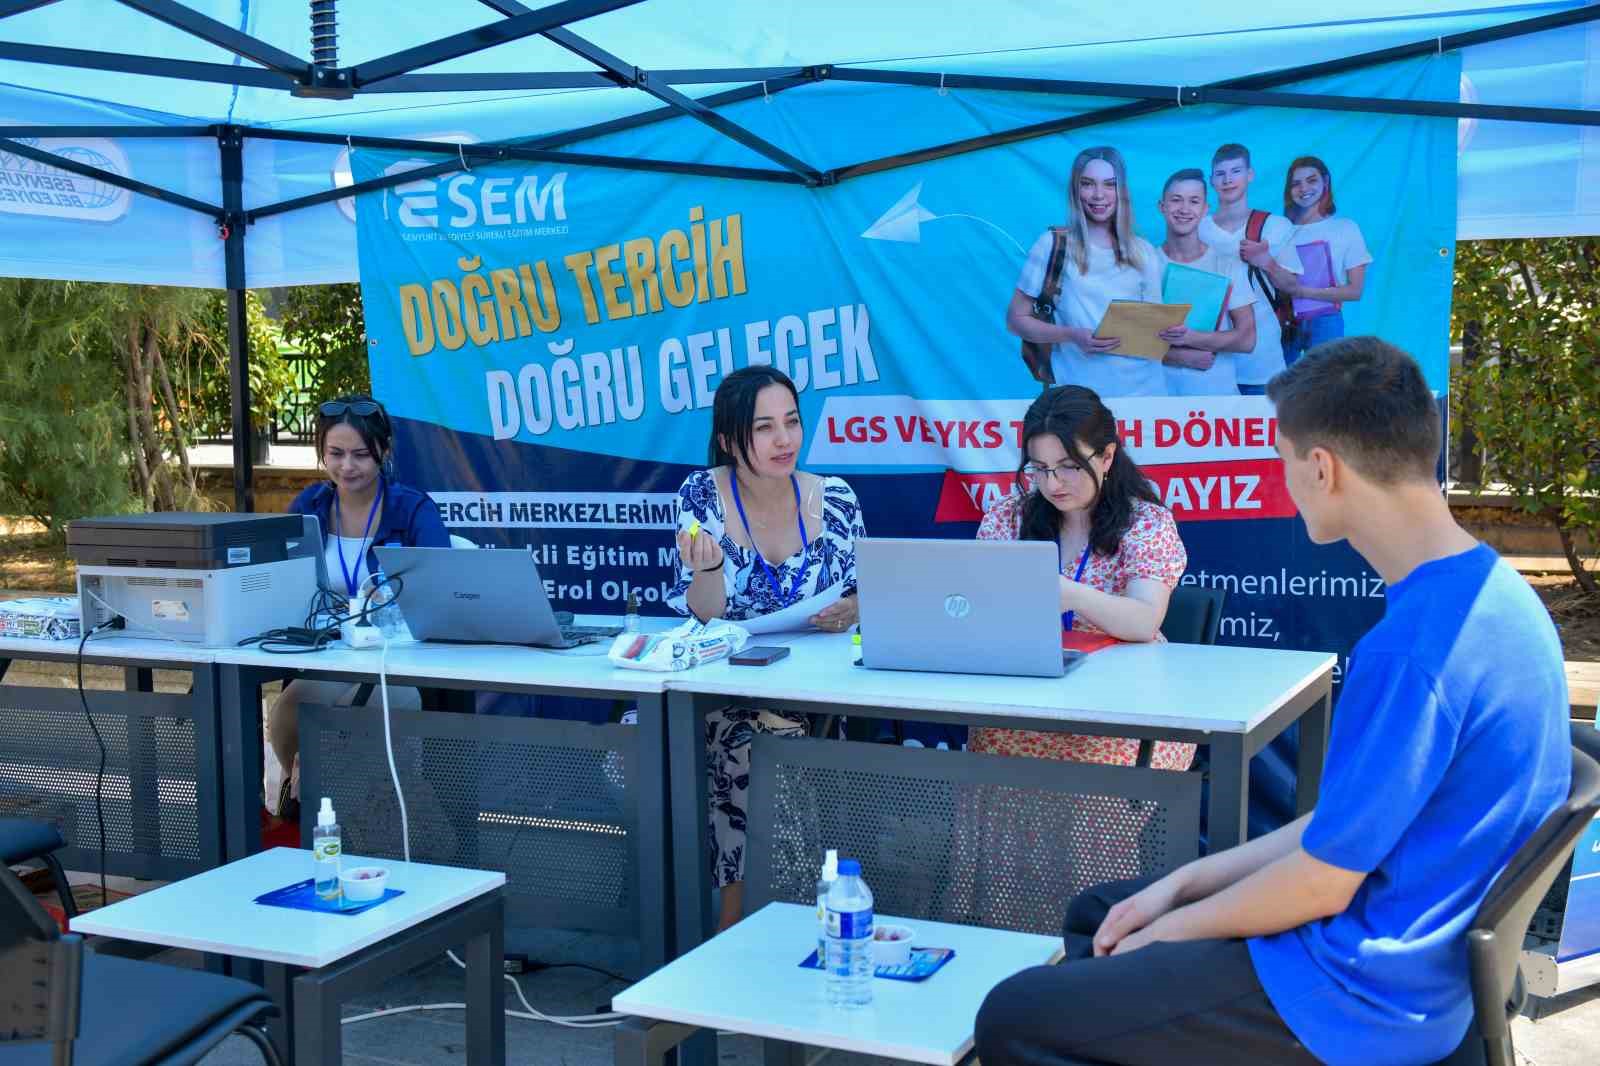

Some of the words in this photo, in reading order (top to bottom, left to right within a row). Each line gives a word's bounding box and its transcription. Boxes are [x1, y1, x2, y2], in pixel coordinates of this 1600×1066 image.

[399, 255, 562, 357] DOĞRU
[563, 204, 748, 326] TERCİH
[485, 338, 645, 440] DOĞRU
[827, 416, 888, 443] LGS
[933, 420, 1004, 448] YKS
[439, 498, 503, 522] ERCİH
[509, 499, 678, 524] MERKEZLERİMİ
[567, 546, 649, 570] Eğitim
[543, 579, 592, 600] Erol
[1180, 568, 1385, 598] etmenlerimiz
[1219, 611, 1281, 642] miz,
